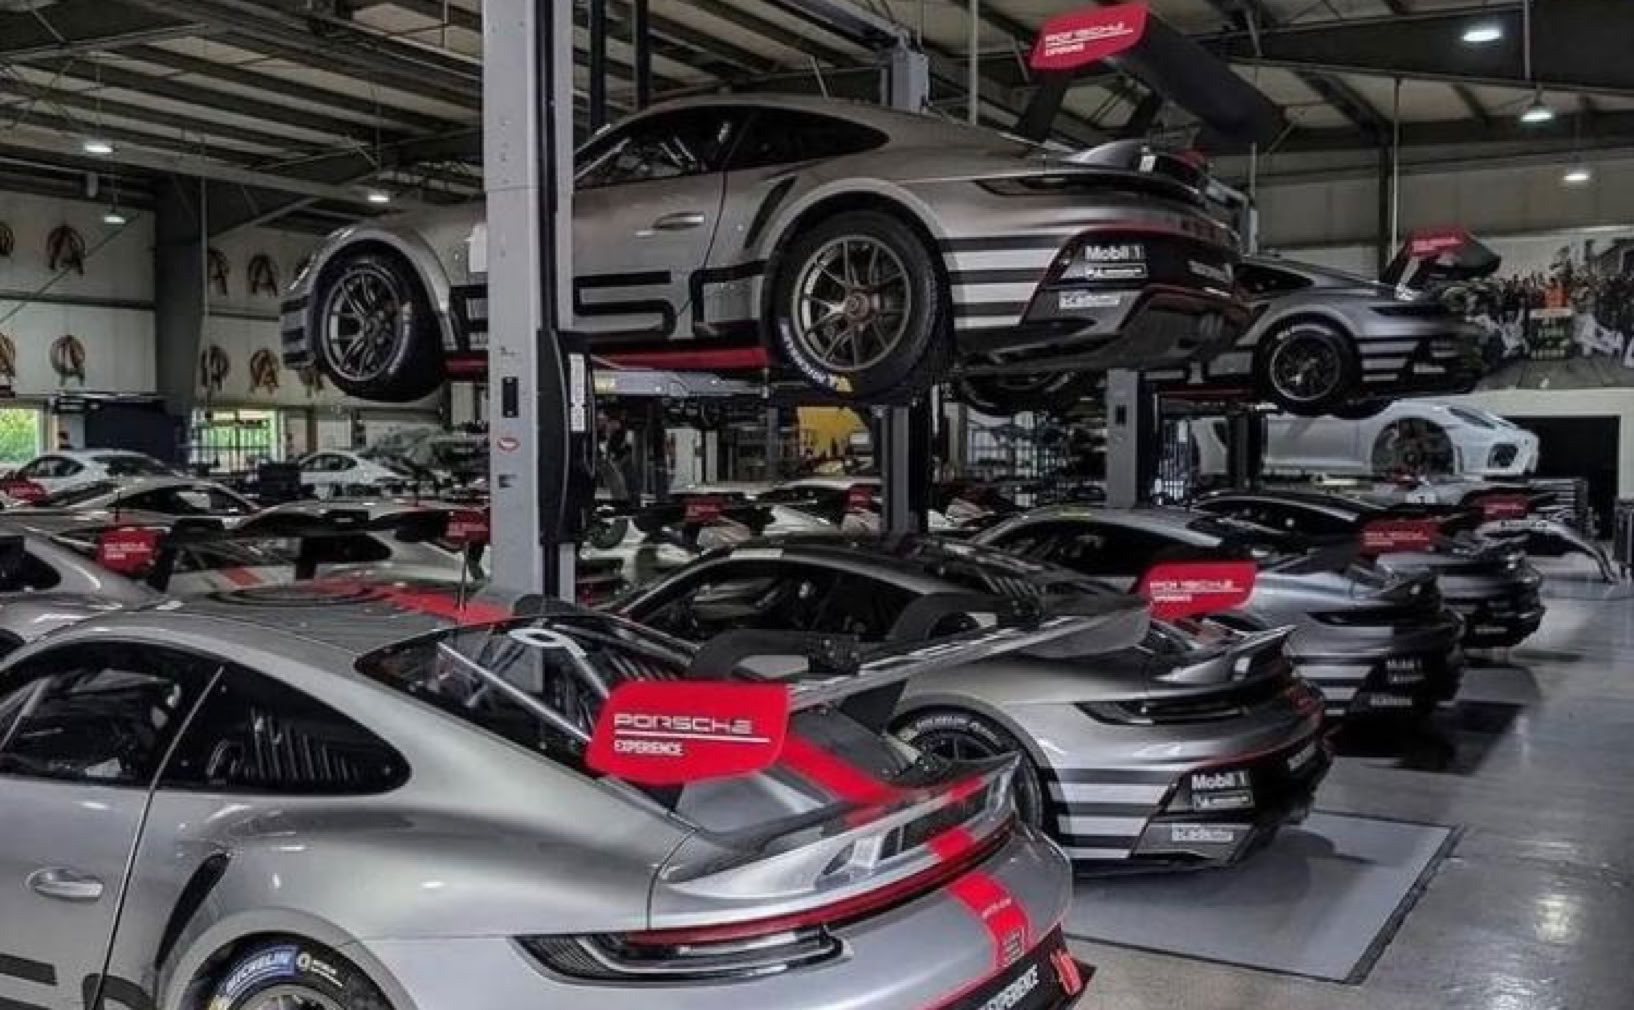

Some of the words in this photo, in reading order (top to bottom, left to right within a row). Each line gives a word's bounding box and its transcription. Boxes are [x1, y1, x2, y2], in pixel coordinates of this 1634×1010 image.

[1085, 246, 1130, 260] Mobil
[1134, 246, 1141, 259] 1
[614, 713, 752, 734] PORSCHE
[614, 739, 684, 756] EXPERIENCE
[1191, 773, 1235, 789] Mobil
[1238, 771, 1246, 785] 1
